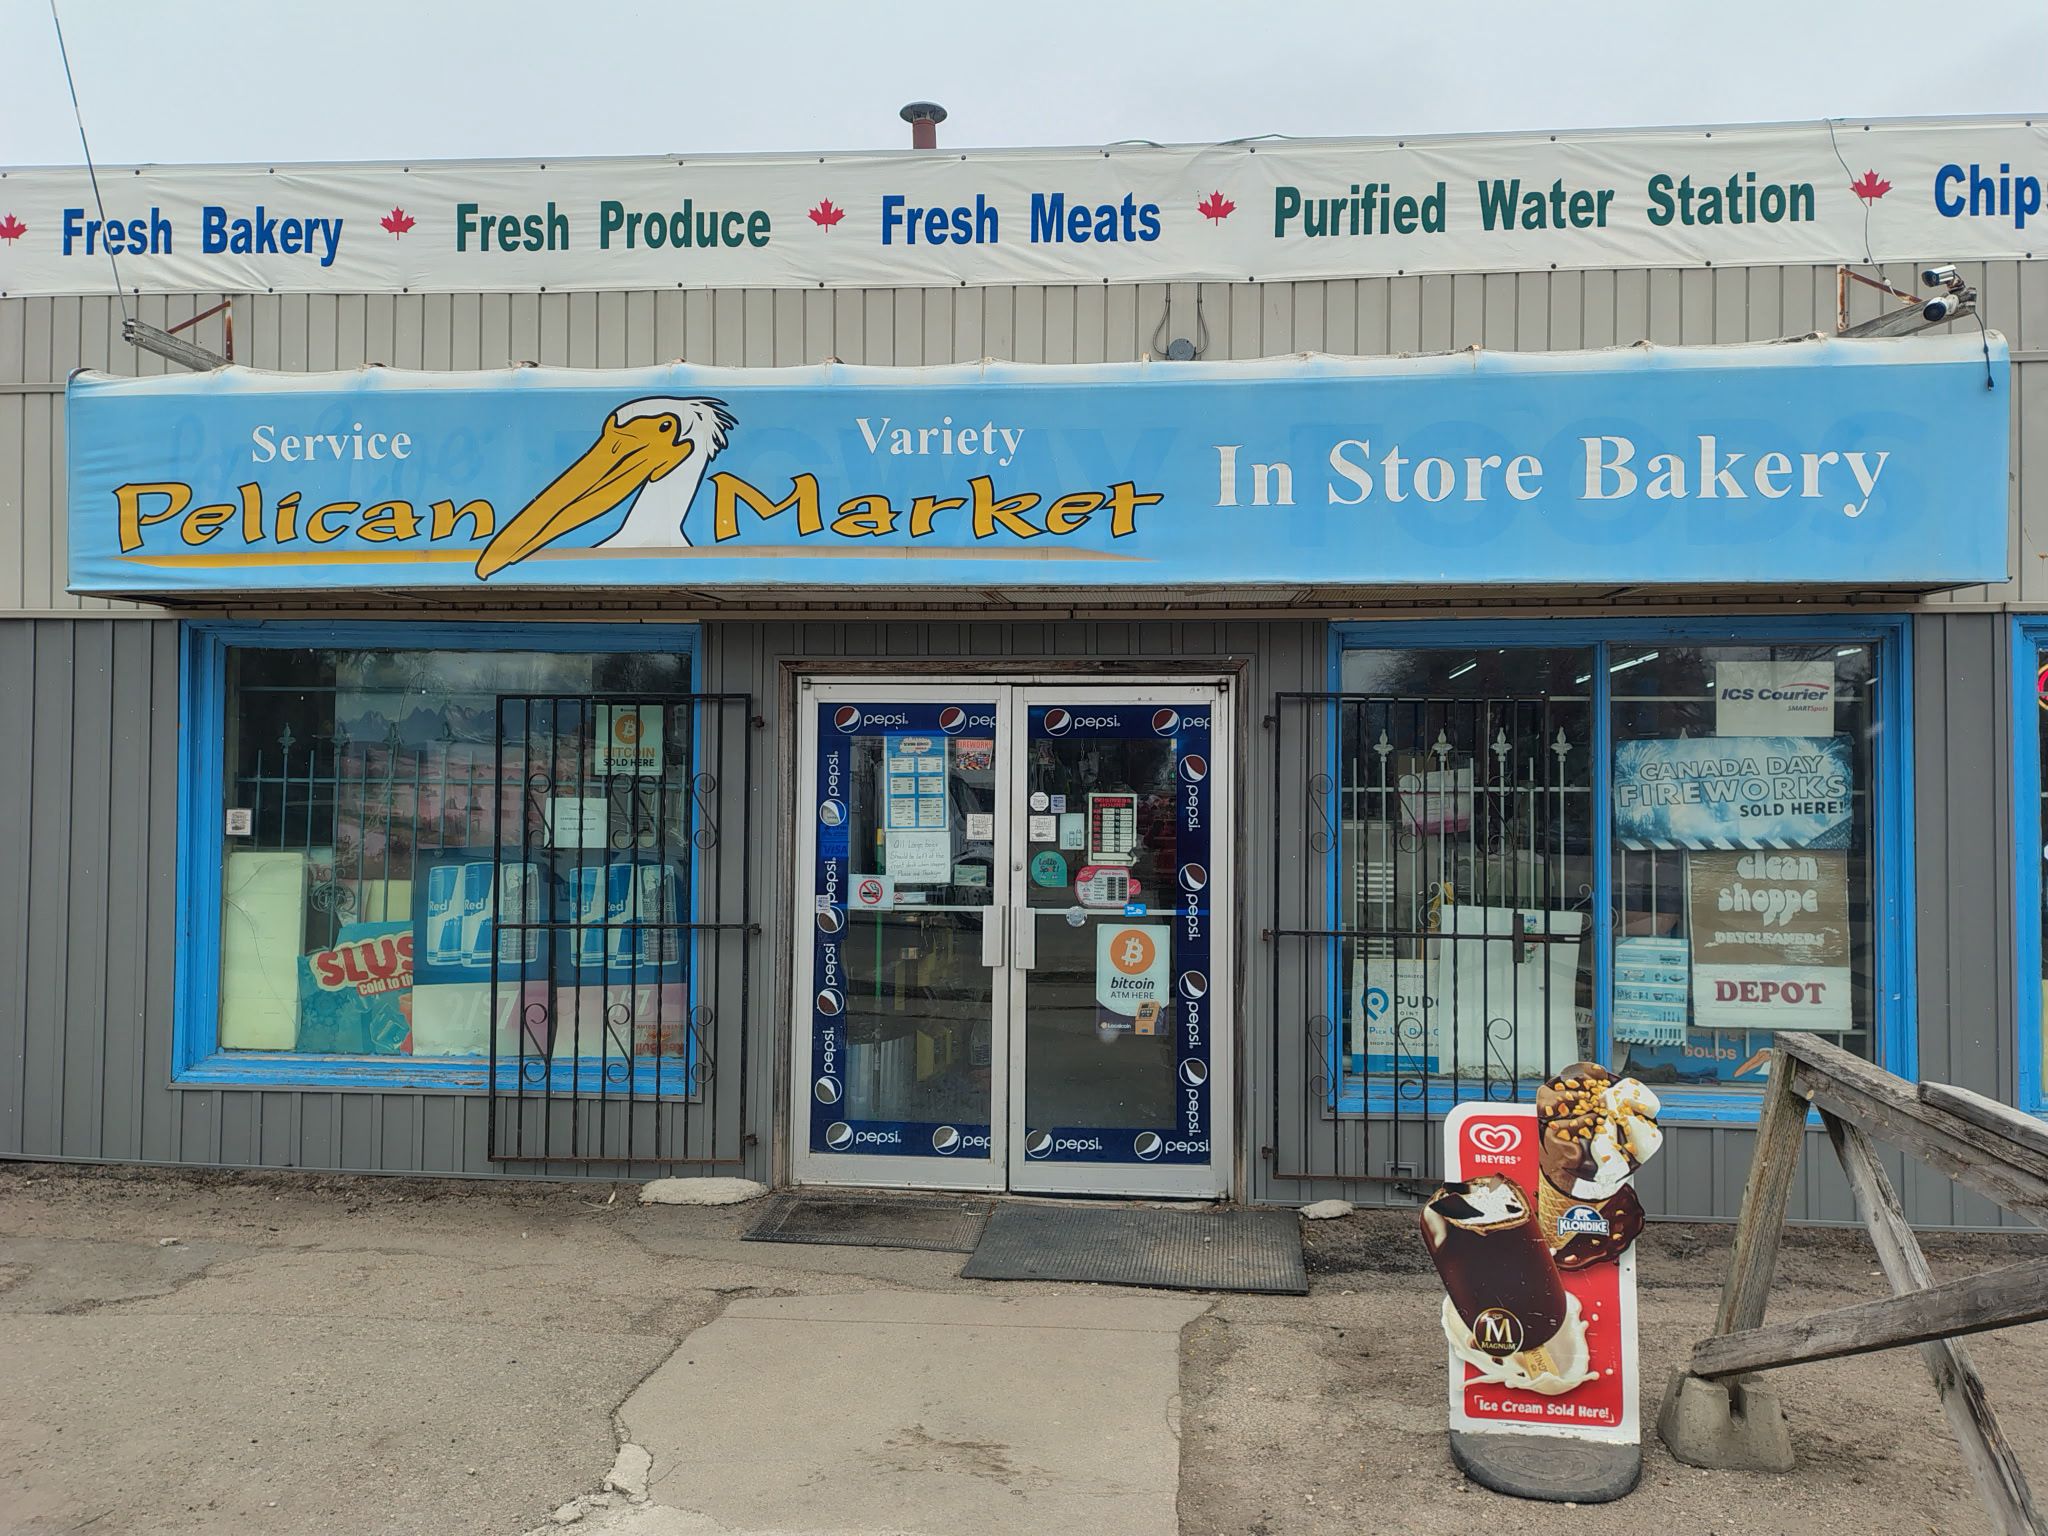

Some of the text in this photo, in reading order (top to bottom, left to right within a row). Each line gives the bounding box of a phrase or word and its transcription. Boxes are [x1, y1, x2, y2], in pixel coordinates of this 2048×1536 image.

[1275, 172, 1814, 237] Purified Water Station
[1935, 163, 2048, 229] Chip
[457, 199, 770, 251] Fresh Produce
[883, 193, 1160, 245] Fresh Meats
[63, 206, 343, 267] Fresh Bakery
[252, 423, 411, 463] Service
[856, 417, 1024, 466] Variety
[1215, 445, 1295, 506] In
[1328, 440, 1543, 505] Store
[1581, 436, 1889, 517] Bakery
[112, 480, 495, 553] Pelican
[707, 472, 1165, 544] Market
[1722, 688, 1828, 701] ICS Courier
[863, 712, 906, 727] pepsi
[1074, 714, 1118, 730] pepsi
[603, 758, 655, 767] SOLD HERE
[827, 751, 840, 797] pepsi
[1640, 755, 1824, 781] CANADA DAY
[1619, 775, 1847, 807] FIREWORKS
[1186, 785, 1201, 832] pepsi
[1740, 801, 1845, 817] SOLD HERE!
[825, 857, 838, 903] pepsi
[1737, 851, 1818, 881] clean
[464, 898, 485, 910] Red
[1186, 894, 1201, 941] pepsi
[1718, 882, 1819, 927] shoppe
[823, 943, 838, 986] pepsi
[359, 979, 386, 995] cold
[1110, 976, 1155, 989] bitcoin
[1110, 991, 1154, 1000] ATM HERE
[1715, 980, 1827, 1005] DEPOT
[1396, 995, 1439, 1009] PUD
[1186, 1001, 1202, 1049] pepsi
[822, 1026, 836, 1074] pepsi
[1186, 1088, 1202, 1137] pepsi
[856, 1130, 901, 1146] pepsi
[1055, 1137, 1101, 1153] pepsi
[1165, 1139, 1209, 1155] pepsi
[1474, 1154, 1517, 1165] BREYERS
[1560, 1220, 1609, 1236] KLONDIKE
[1484, 1318, 1513, 1343] M
[1481, 1340, 1517, 1350] MAGNUM
[1479, 1399, 1609, 1419] Ice Cream Sold Here!
